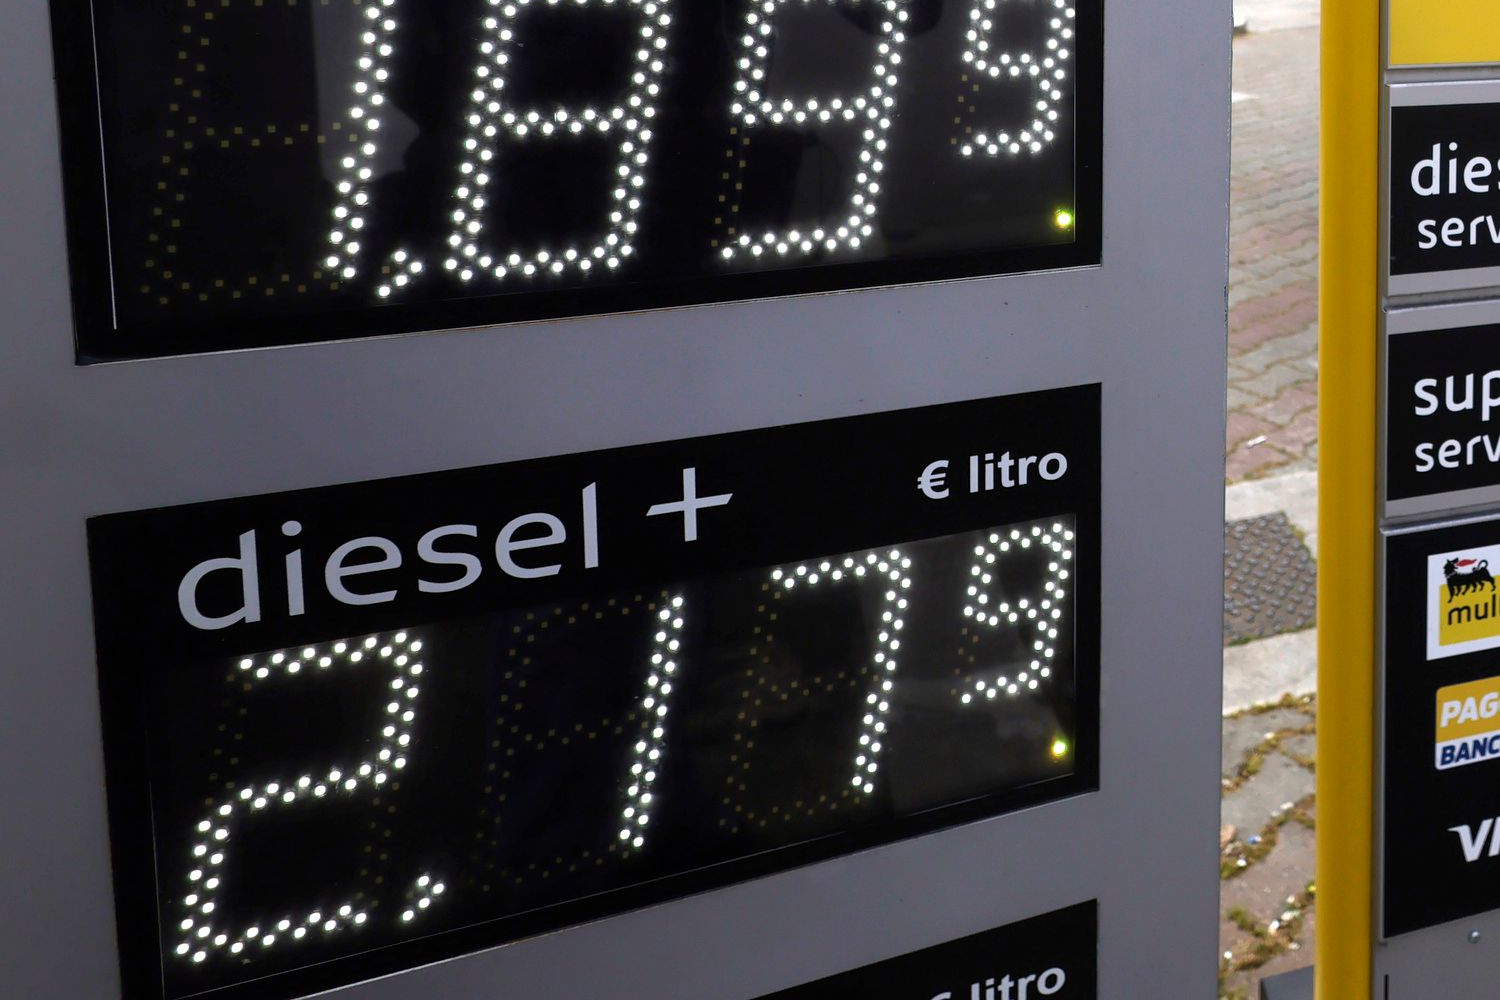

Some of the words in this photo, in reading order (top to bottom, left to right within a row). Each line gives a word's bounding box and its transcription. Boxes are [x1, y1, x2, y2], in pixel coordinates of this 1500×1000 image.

[917, 460, 949, 500] €
[969, 451, 1068, 493] litro
[176, 482, 599, 632] diesel
